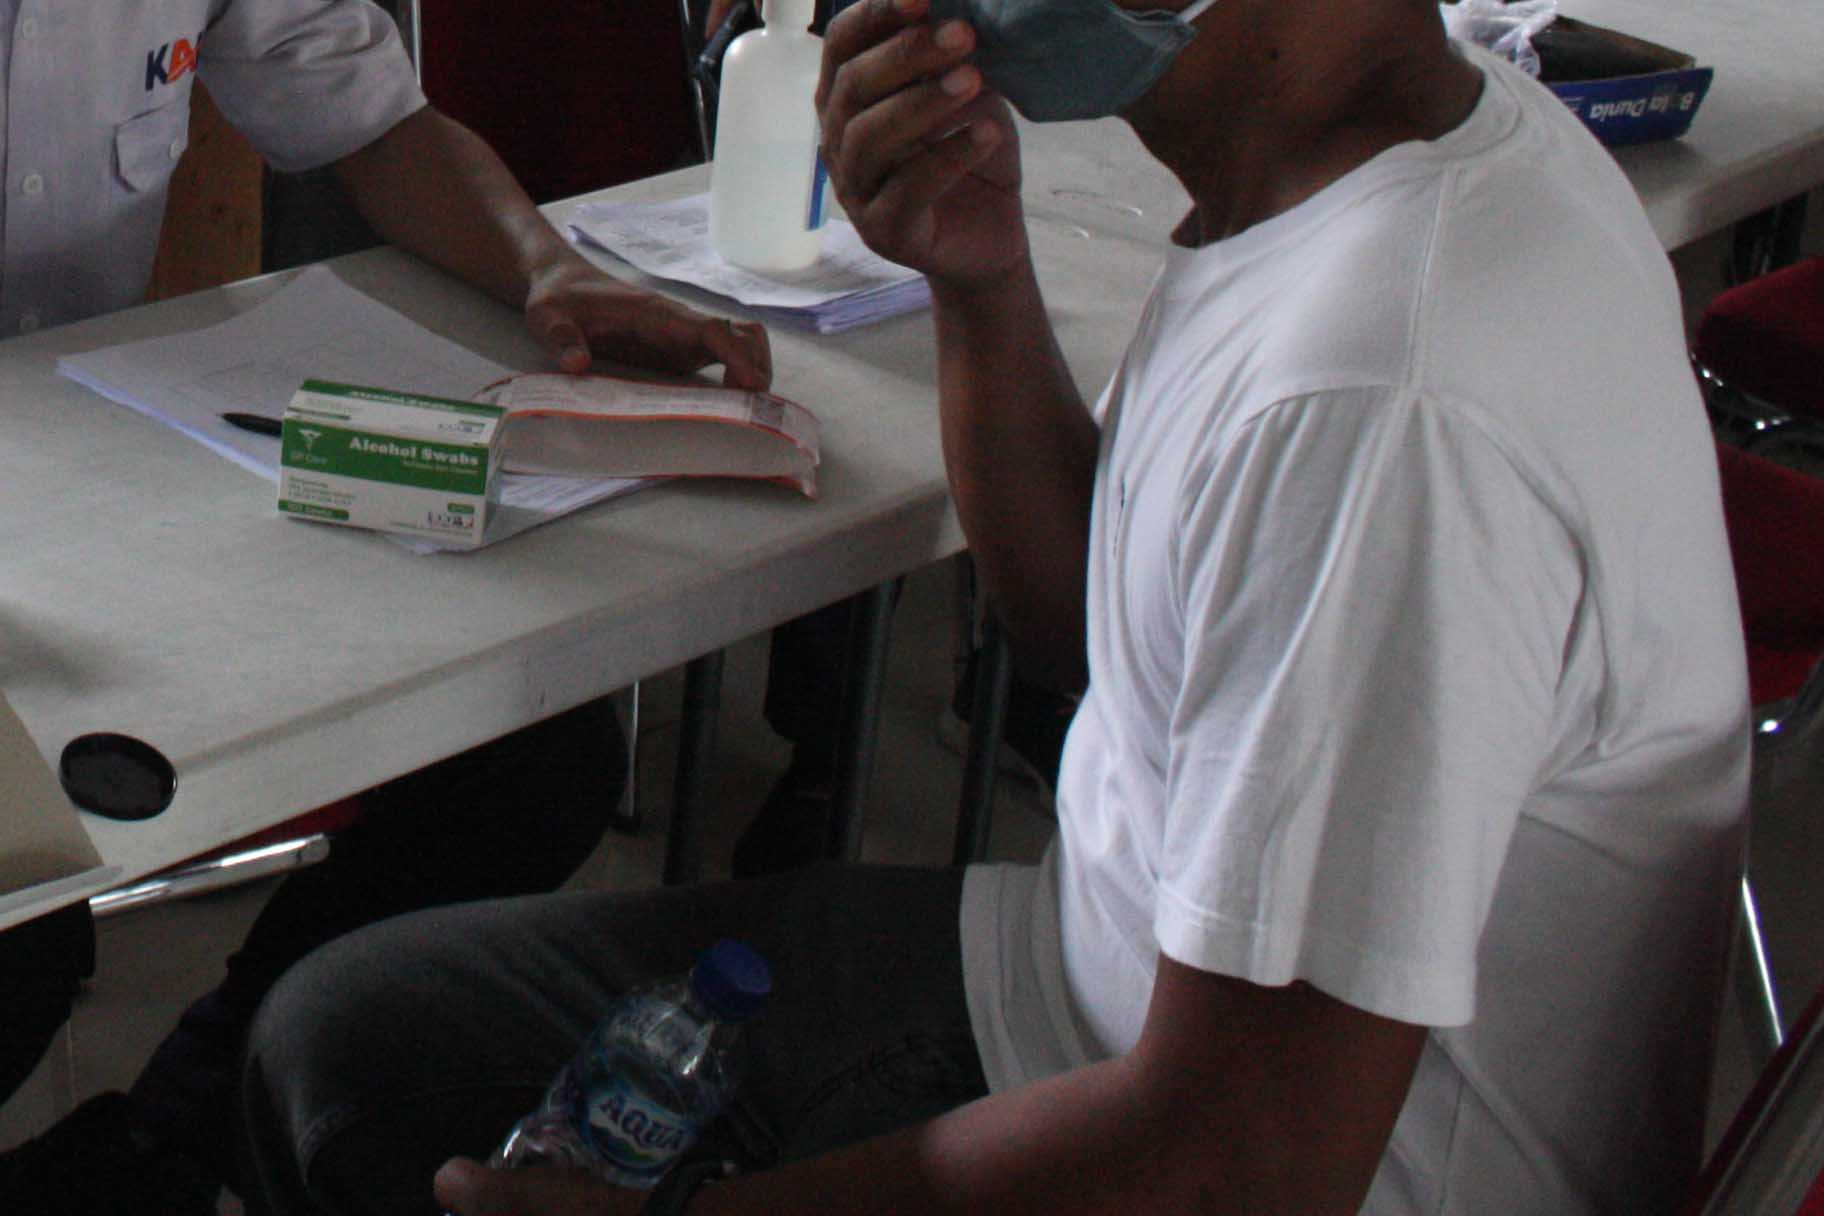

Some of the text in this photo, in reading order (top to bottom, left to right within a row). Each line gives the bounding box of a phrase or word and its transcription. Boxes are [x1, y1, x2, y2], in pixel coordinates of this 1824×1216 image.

[348, 436, 480, 466] Alcohol Swabs
[598, 1094, 687, 1152] AQUA
